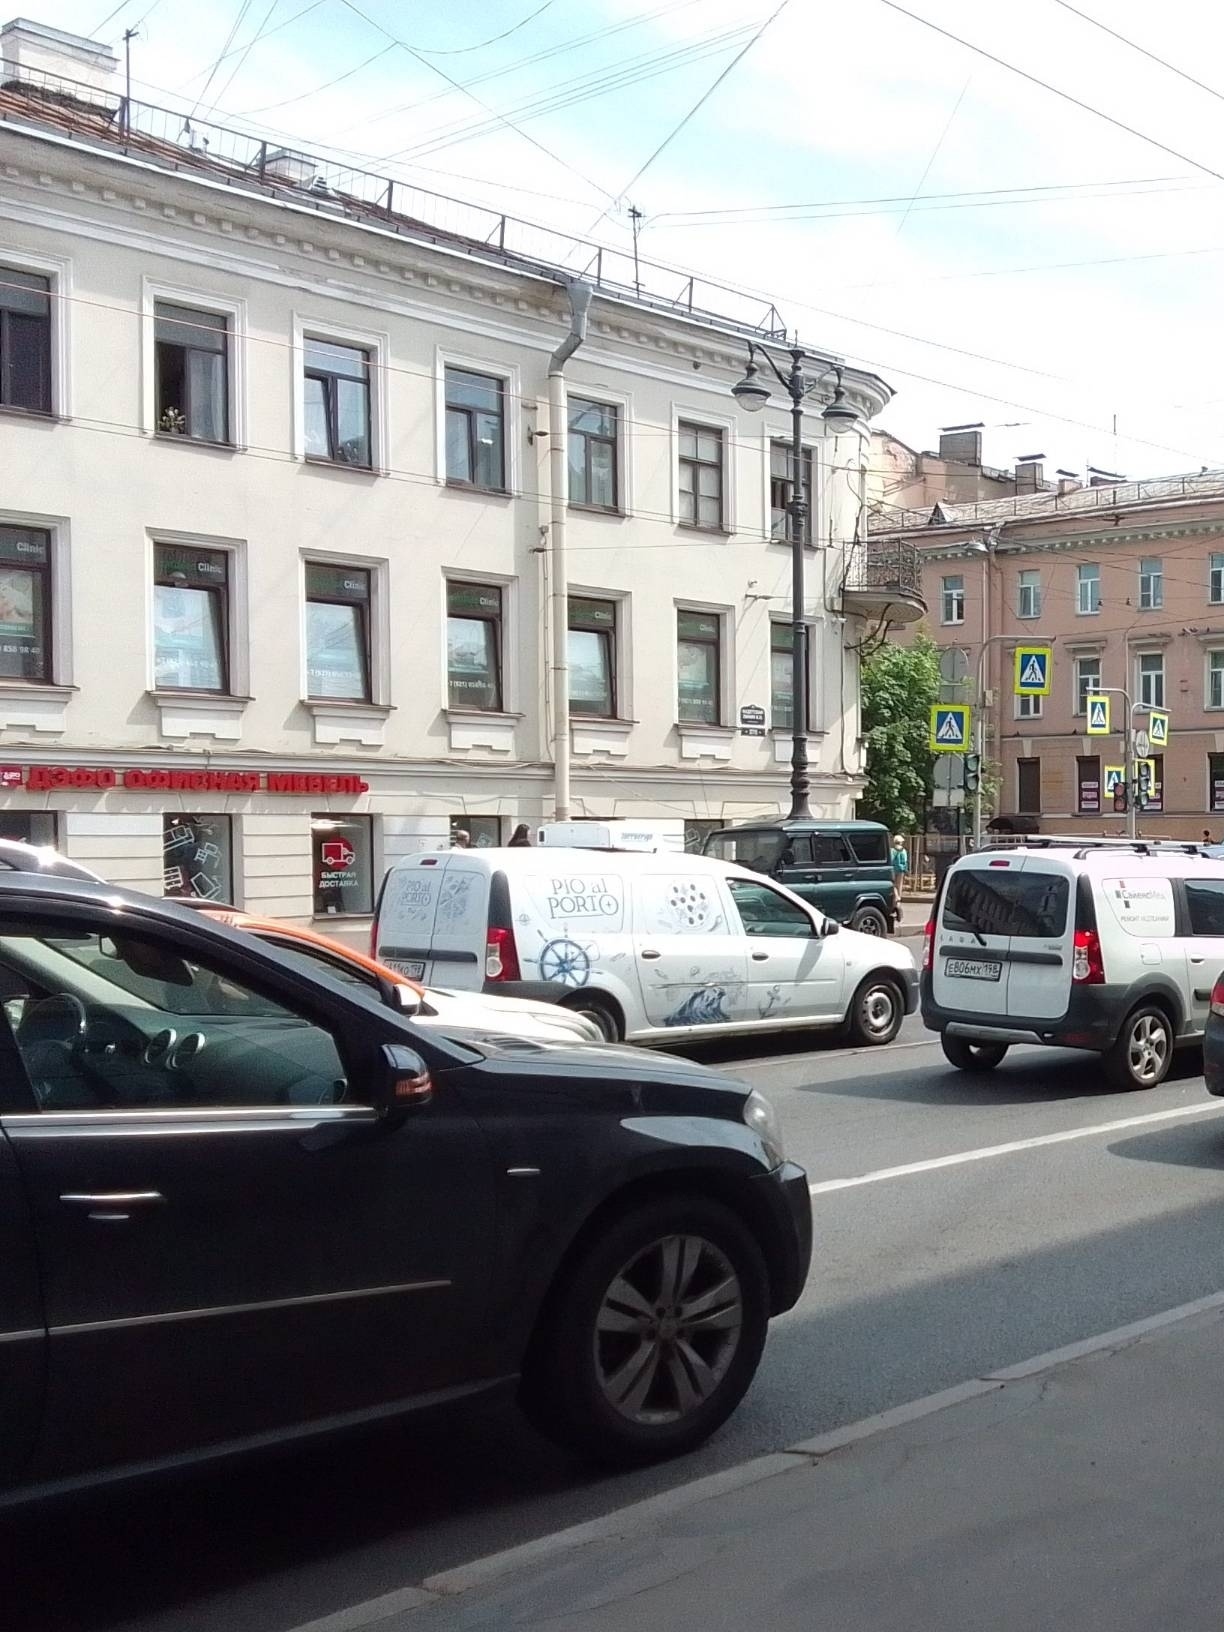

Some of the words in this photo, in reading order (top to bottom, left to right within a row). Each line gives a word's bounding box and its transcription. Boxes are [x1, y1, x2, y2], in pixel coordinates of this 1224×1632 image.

[16, 542, 44, 554] Clinic
[197, 562, 223, 574] Clinic
[26, 766, 116, 791] ДЭФО
[124, 769, 261, 793] ОФИСНАЯ
[267, 772, 369, 794] МЕБЕЛЬ
[321, 871, 356, 880] БЫСТРАЯ
[319, 879, 359, 888] ДОСТАВКА
[551, 878, 586, 895] PIO
[592, 877, 608, 894] al
[548, 894, 619, 919] PORTO
